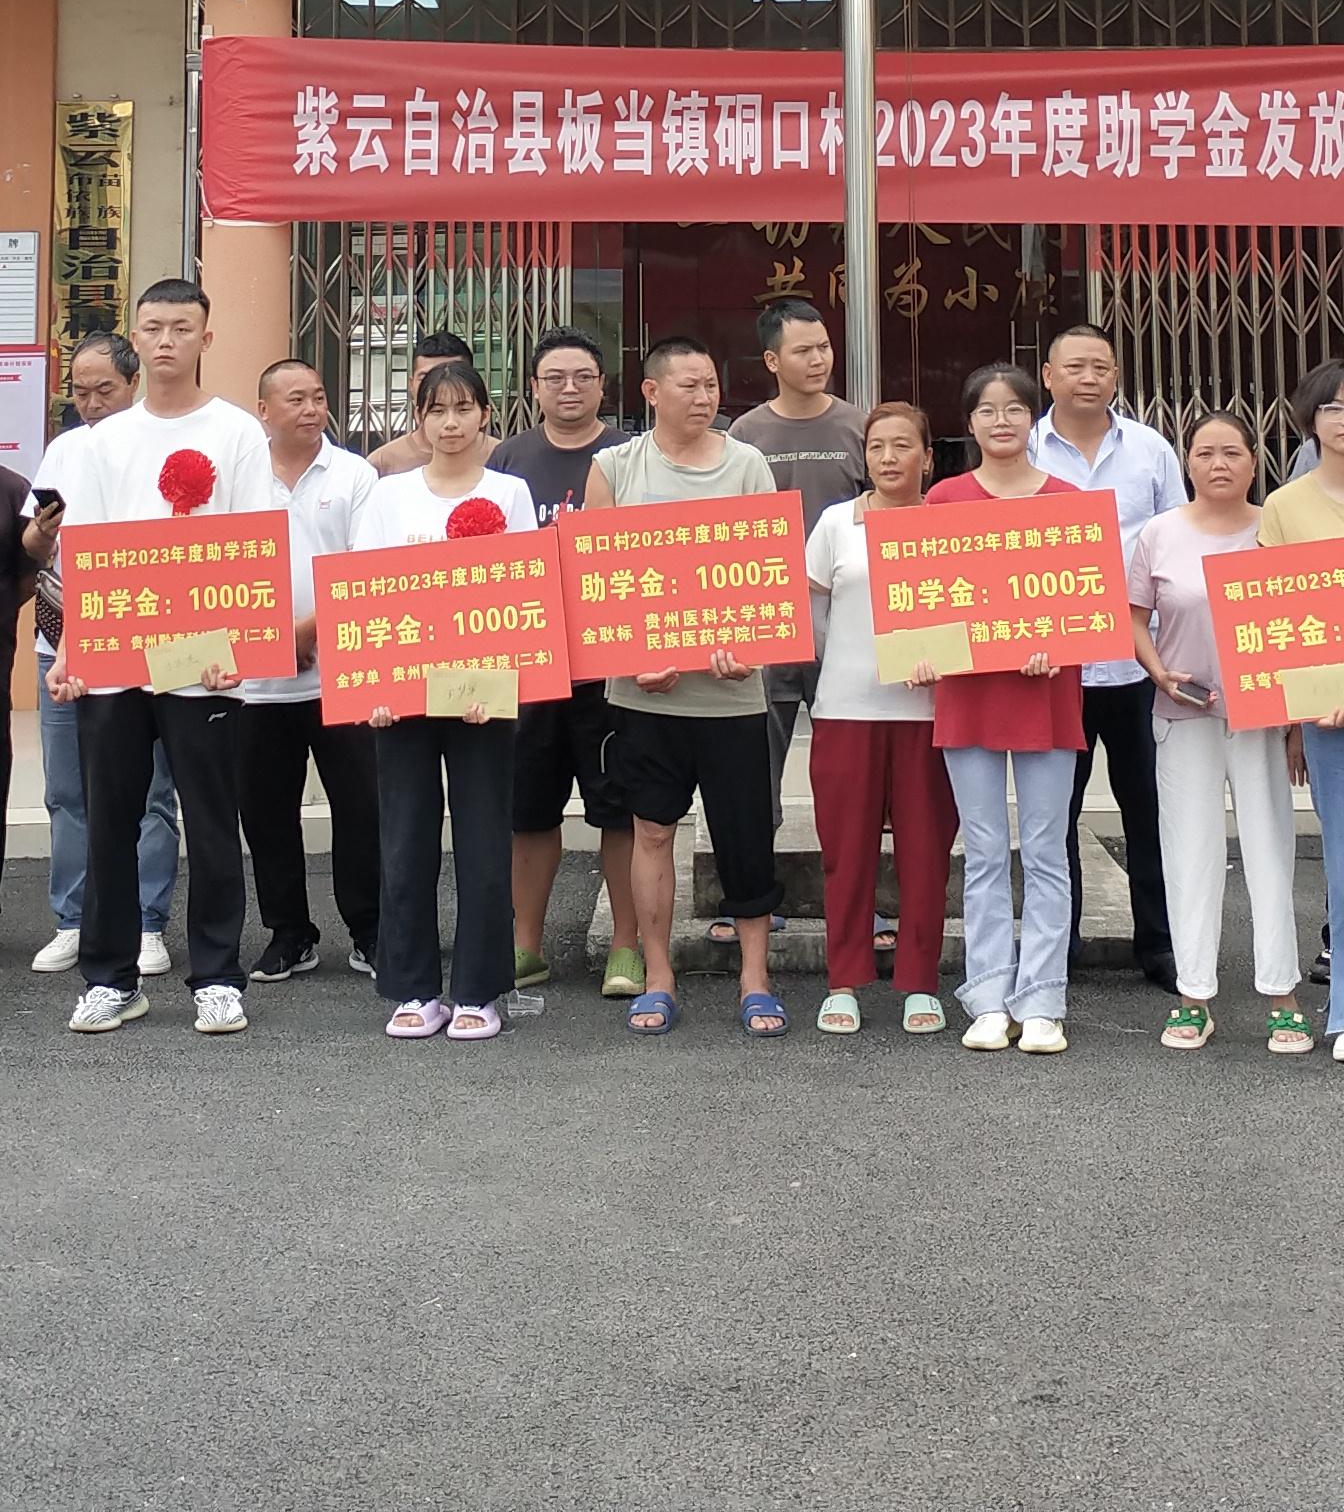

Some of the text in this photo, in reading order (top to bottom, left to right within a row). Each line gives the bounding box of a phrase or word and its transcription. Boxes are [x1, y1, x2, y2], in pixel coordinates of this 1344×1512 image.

[75, 538, 276, 571] 硐口村2023年度助学活动
[575, 516, 788, 554] 硐口村2023年度助学活动
[880, 522, 1103, 561] 硐口村2023年度助学活动
[330, 557, 546, 601] 硐口村2023年度助学活动
[580, 557, 790, 603] 助学金：1000元
[887, 565, 1106, 613] 助学金：1000元
[80, 580, 276, 621] 助学金：1000元
[336, 600, 547, 652] 助学金：1000元
